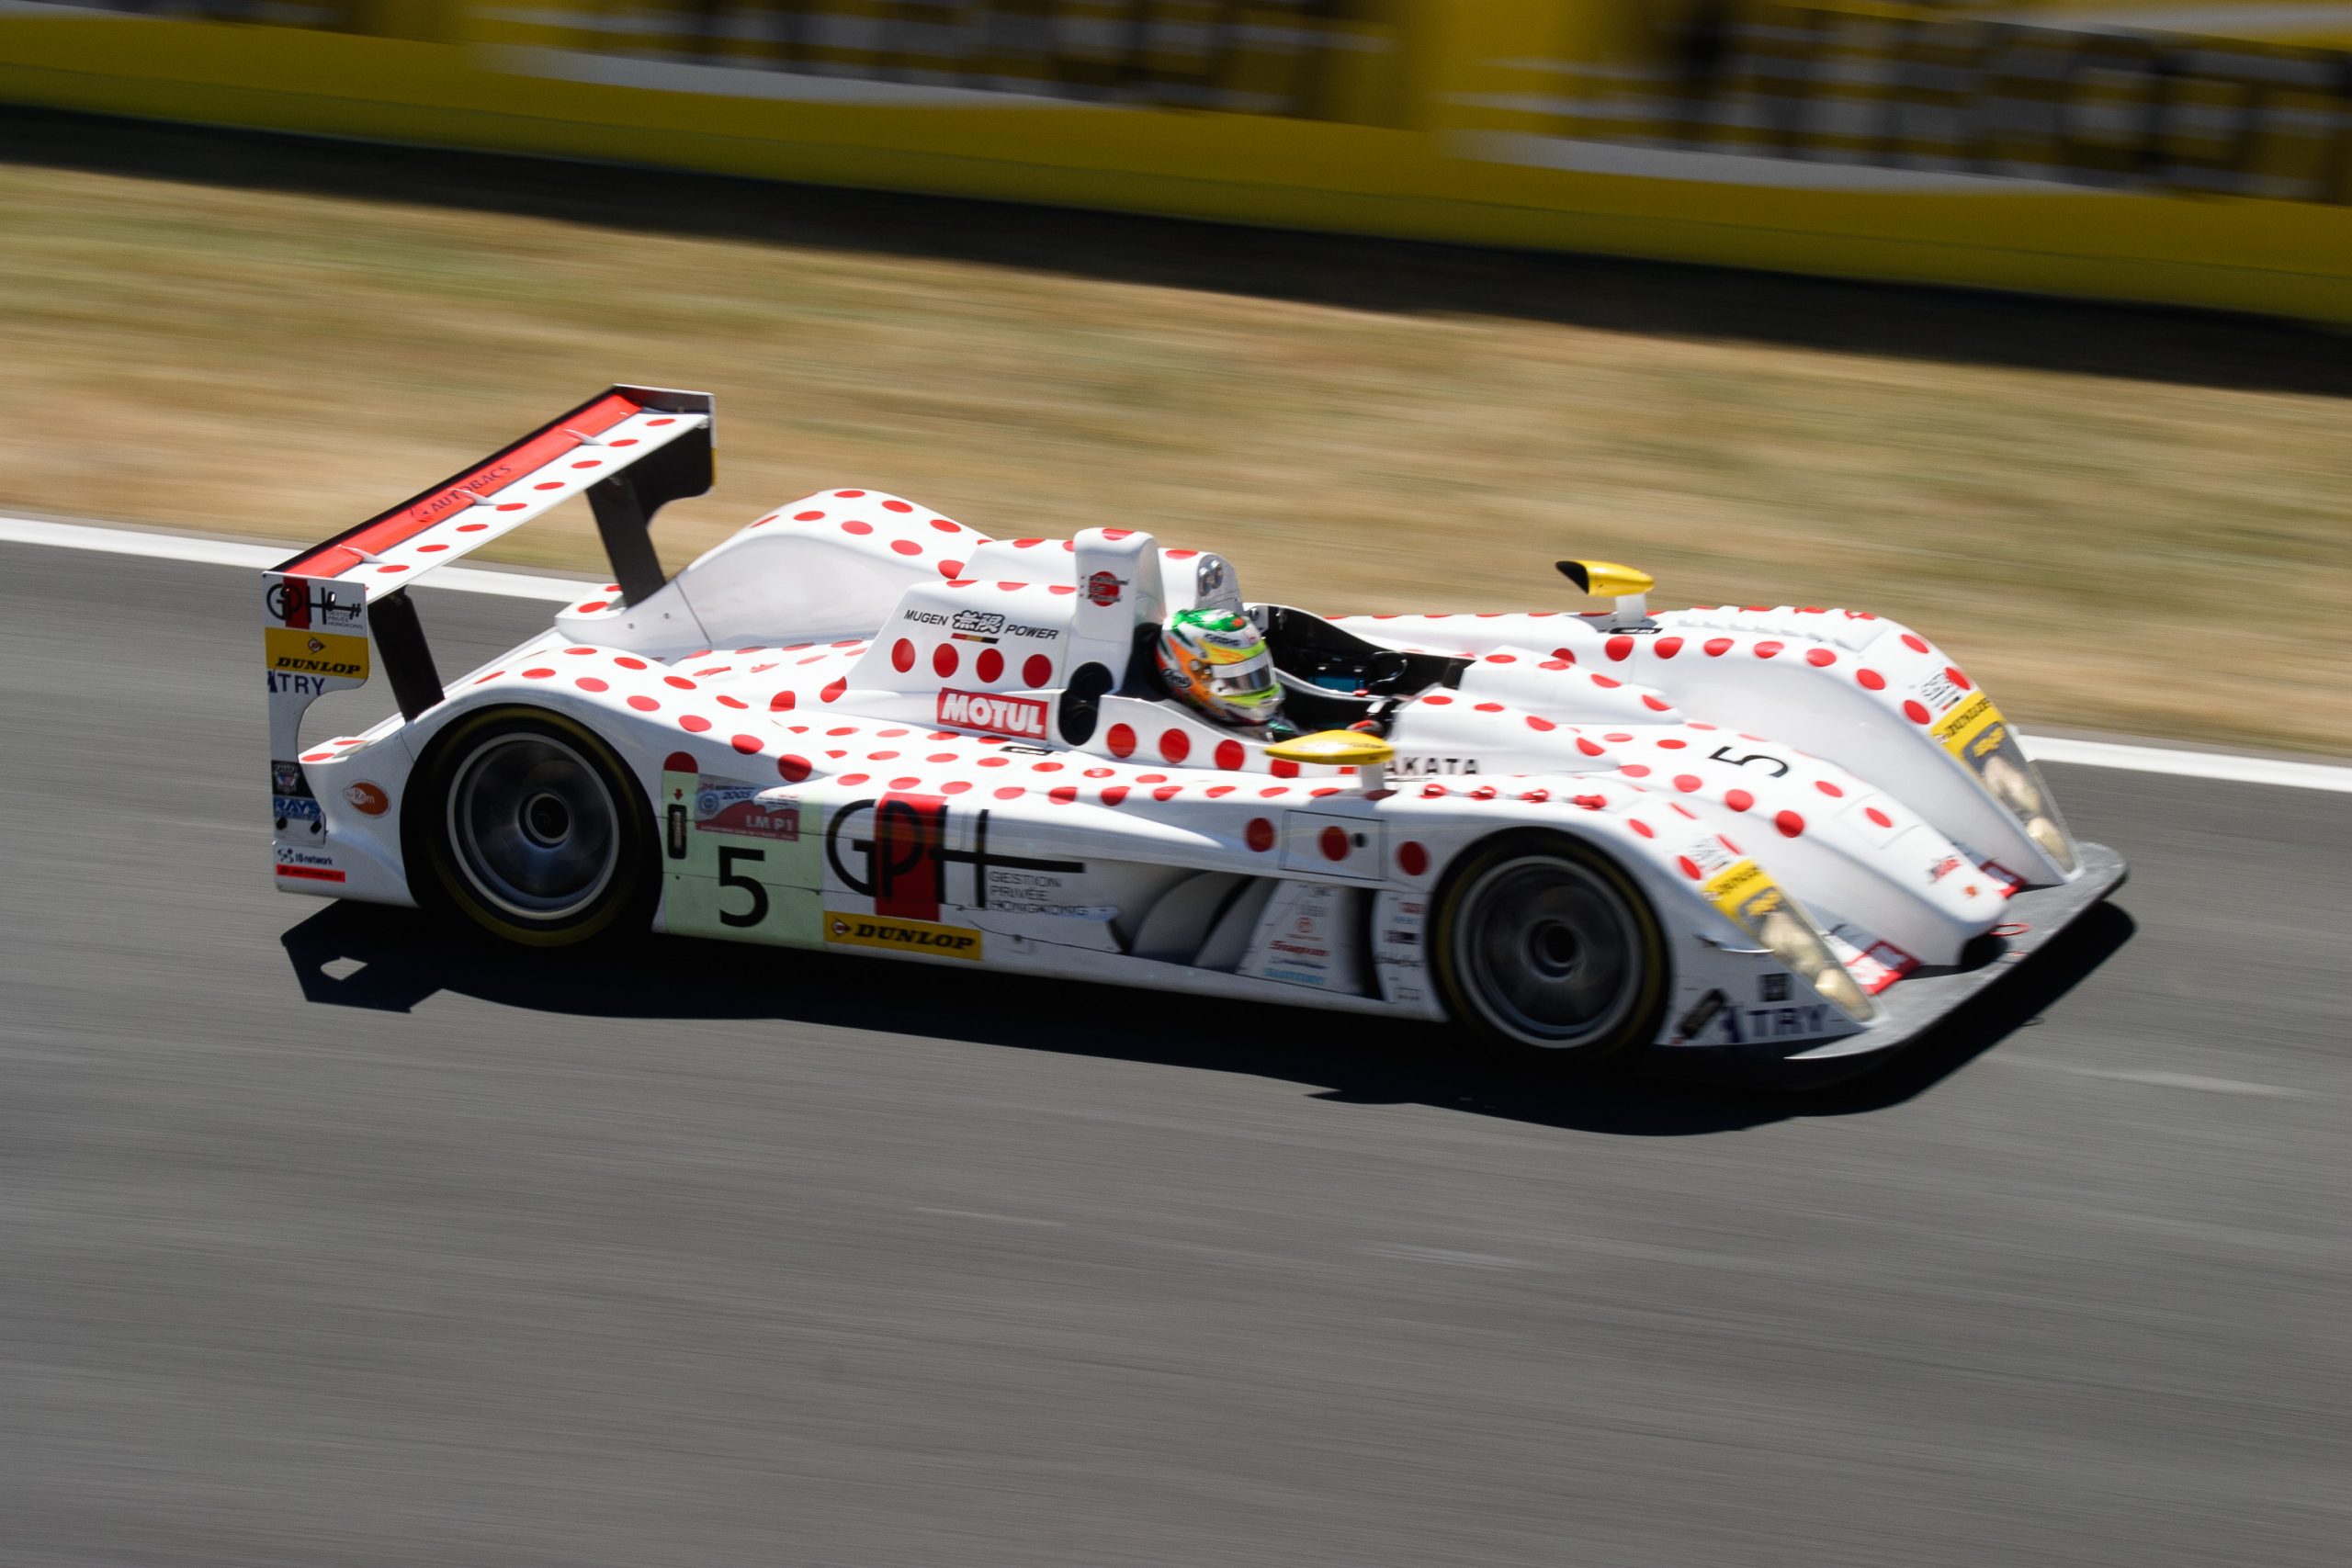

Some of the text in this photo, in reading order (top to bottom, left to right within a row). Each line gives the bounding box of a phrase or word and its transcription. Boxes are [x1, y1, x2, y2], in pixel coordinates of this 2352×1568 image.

[904, 610, 1059, 640] MUGEN 無限 POWER
[277, 657, 361, 674] DUNLOP
[941, 694, 1044, 734] MOTUL
[1384, 756, 1488, 775] AKATA
[1708, 746, 1789, 778] 5
[826, 798, 1085, 908] GPH
[718, 845, 769, 928] 5
[989, 871, 1062, 888] GESTION
[855, 923, 974, 950] DUNLOP
